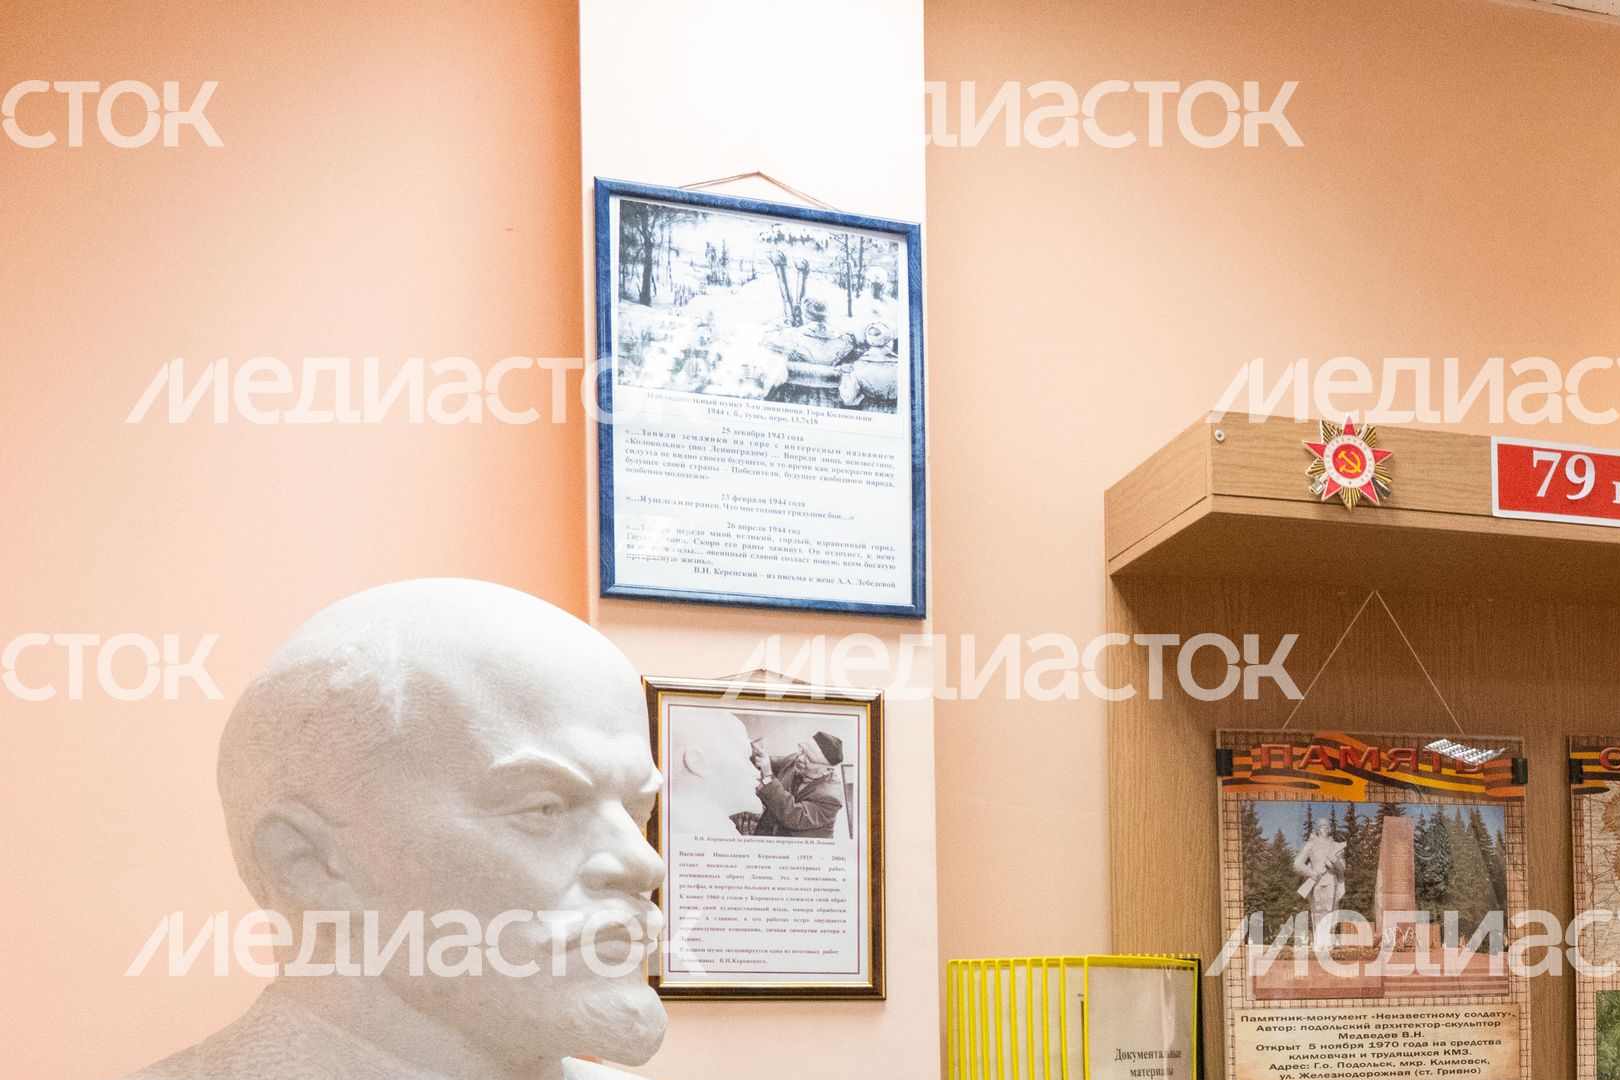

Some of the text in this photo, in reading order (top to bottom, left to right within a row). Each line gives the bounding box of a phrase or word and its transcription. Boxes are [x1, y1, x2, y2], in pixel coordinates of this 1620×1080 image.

[1532, 449, 1596, 501] 79
[1260, 743, 1486, 775] ПАМЯТЬ
[1255, 1020, 1500, 1033] Автор: подольский архитектор-скульптор
[1337, 1030, 1424, 1041] Медведев В.Н.
[1255, 1043, 1299, 1053] Открыт
[1308, 1042, 1316, 1050] 5
[1320, 1042, 1364, 1051] ноября
[1368, 1040, 1399, 1048] 1970
[1402, 1041, 1428, 1049] года
[1449, 1039, 1501, 1048] средства
[1288, 1052, 1355, 1060] климовчан
[1370, 1050, 1439, 1059] трудящихся
[1443, 1048, 1471, 1056] КМЗ.
